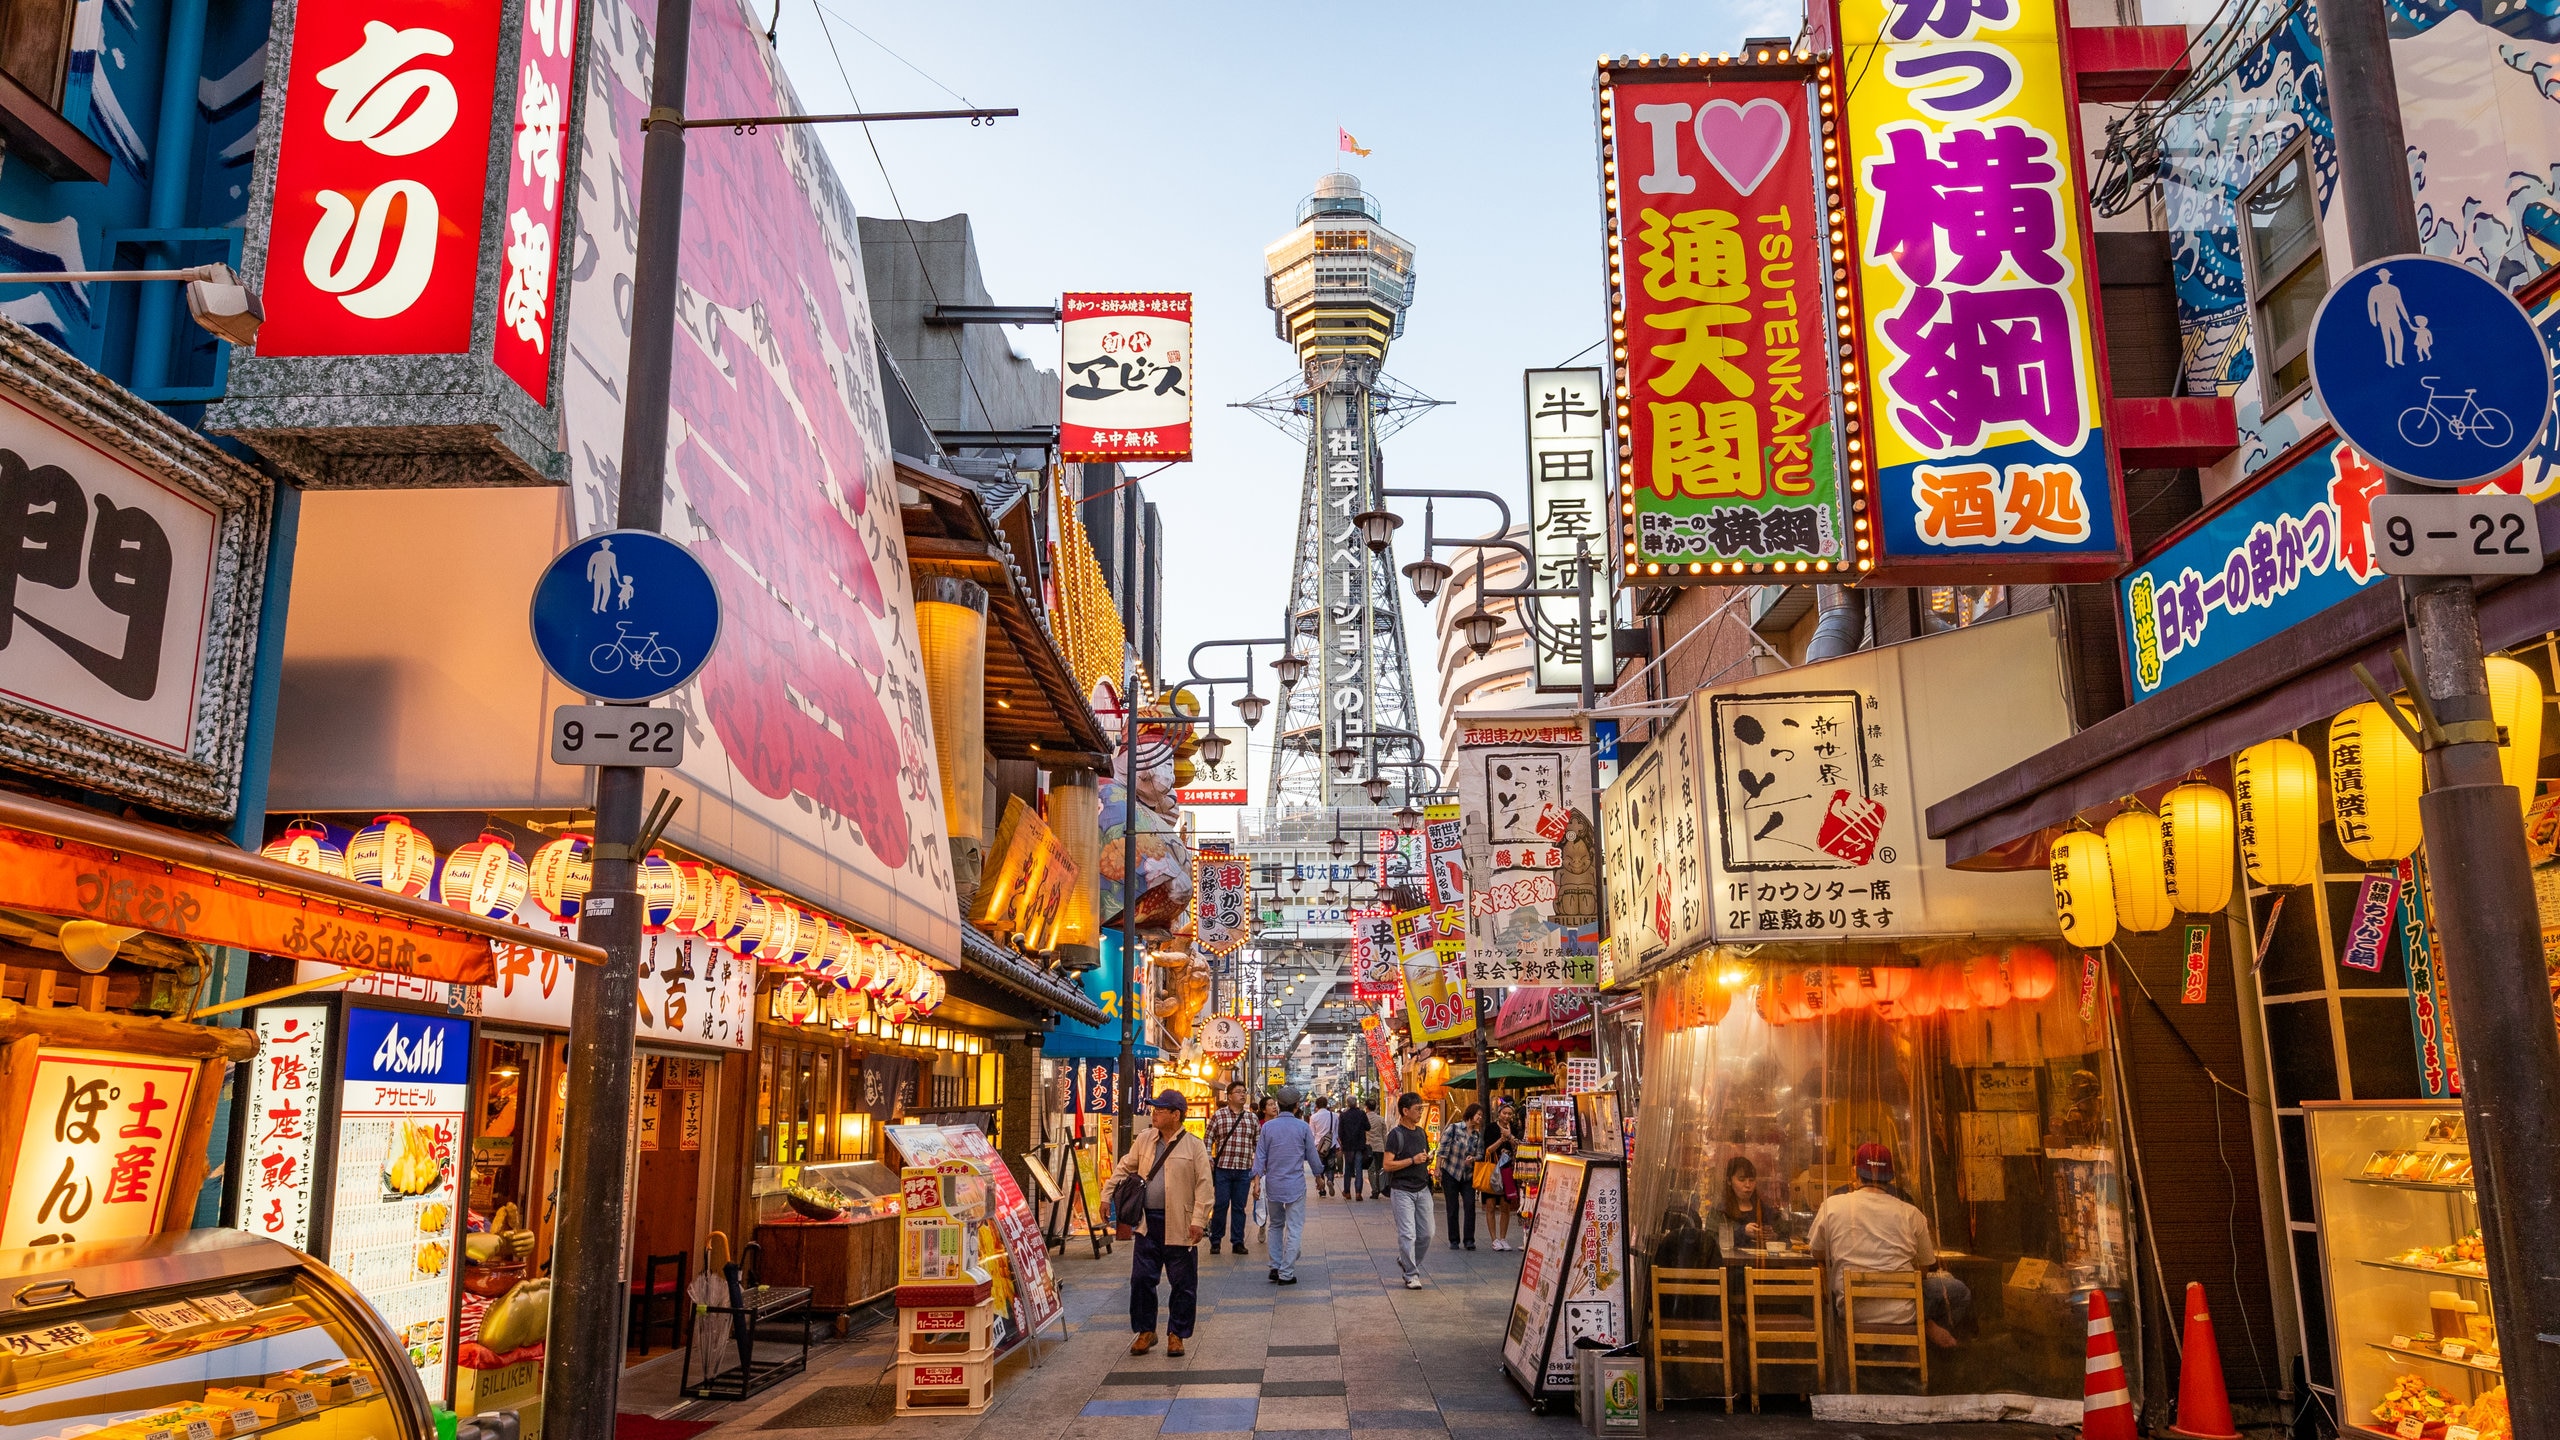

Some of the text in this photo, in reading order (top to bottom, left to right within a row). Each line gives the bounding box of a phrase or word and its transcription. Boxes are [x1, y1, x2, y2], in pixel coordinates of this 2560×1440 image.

[303, 20, 460, 319] ちり
[1635, 102, 1696, 195] I
[1068, 299, 1187, 312] 串かつ・お好み焼き・焼きそば
[1871, 126, 2080, 450] 横綱
[1102, 331, 1152, 353] 初代
[1639, 206, 1761, 498] 通天閣
[1757, 205, 1810, 493] TSUTENKAKU
[1066, 355, 1186, 401] エビス
[1091, 431, 1159, 448] 年中無休
[1536, 387, 1607, 665] 半田屋酒店
[1641, 515, 1706, 533] 日本一の
[1920, 471, 2082, 538] 酒処
[1643, 534, 1706, 554] 串かつ
[1708, 507, 1822, 556] 横綱
[2157, 510, 2332, 654] 日本一の串かつ
[2132, 576, 2160, 685] 新世界
[1464, 727, 1583, 745] 元祖串カツ専門店
[1811, 715, 1849, 786] 新世界
[1865, 695, 1889, 798] 商標登録
[1184, 791, 1236, 800] 24時間営業中
[1535, 765, 1553, 801] 新世界
[1680, 732, 1693, 810] 元祖
[2331, 717, 2375, 845] 二度漬禁止
[354, 850, 378, 860] Asahi
[394, 832, 407, 882] アサヒビール
[448, 869, 472, 880] Asahi
[475, 855, 502, 903] アサヒビール
[545, 849, 562, 898] アサヒビール
[1432, 853, 1452, 902] 大阪名物
[1496, 848, 1563, 869] 総本店
[1677, 816, 1692, 934] 専門店
[1686, 811, 1701, 928] 串カツ
[651, 882, 672, 890] Asahi
[700, 879, 712, 920] アサヒビール
[719, 884, 735, 925] アサヒビール
[1201, 866, 1217, 929] お好み焼き
[1219, 865, 1243, 928] 串かつ
[1470, 876, 1558, 918] 大阪名物
[2052, 861, 2076, 932] 串かつ
[283, 918, 433, 974] ふぐなら日本一
[1370, 919, 1397, 975] 串かつ
[1473, 961, 1595, 981] 宴会予約受付中
[720, 961, 732, 1040] 串かつ
[373, 1022, 445, 1075] Asahi
[375, 1086, 437, 1107] アサヒビール
[1092, 1065, 1108, 1110] 串かつ
[103, 1081, 168, 1204] 土産
[261, 1020, 309, 1233] 二階座敷も
[29, 1075, 120, 1247] ぽん
[937, 1165, 969, 1174] ガチャ串
[904, 1178, 937, 1194] ガチャ
[906, 1193, 922, 1210] 串
[1588, 1265, 1597, 1298] あります
[918, 1319, 964, 1329] アサヒビール
[481, 1365, 534, 1399] BILLIKEN
[916, 1375, 962, 1384] アサヒビール
